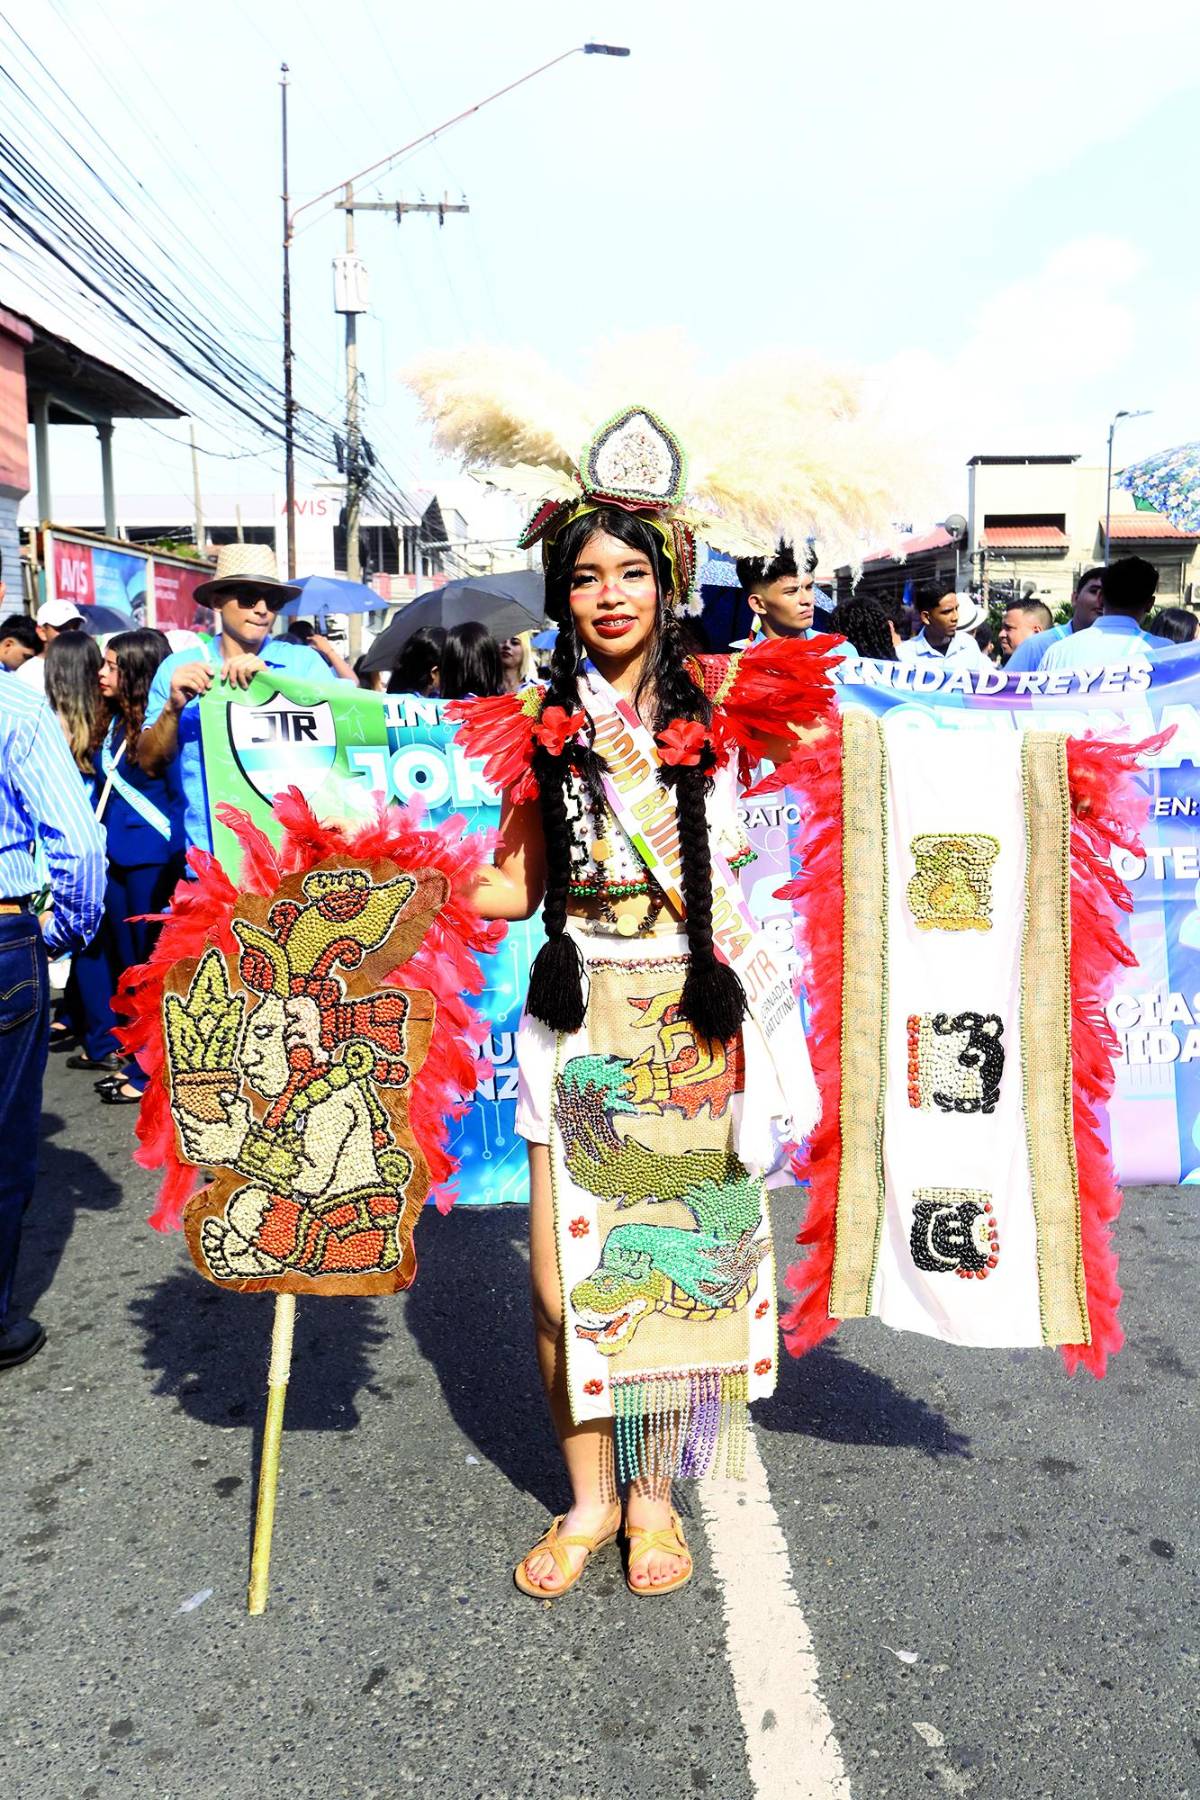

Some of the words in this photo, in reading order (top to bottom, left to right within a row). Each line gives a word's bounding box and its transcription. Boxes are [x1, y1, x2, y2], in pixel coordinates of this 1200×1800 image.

[60, 558, 88, 595] AVIS
[1014, 664, 1155, 695] REYES
[250, 710, 319, 743] JTR
[384, 697, 466, 728] IN
[592, 711, 652, 794] INDIA
[1154, 796, 1198, 816] EN:
[743, 949, 778, 1003] JTR
[1106, 994, 1200, 1028] CIA
